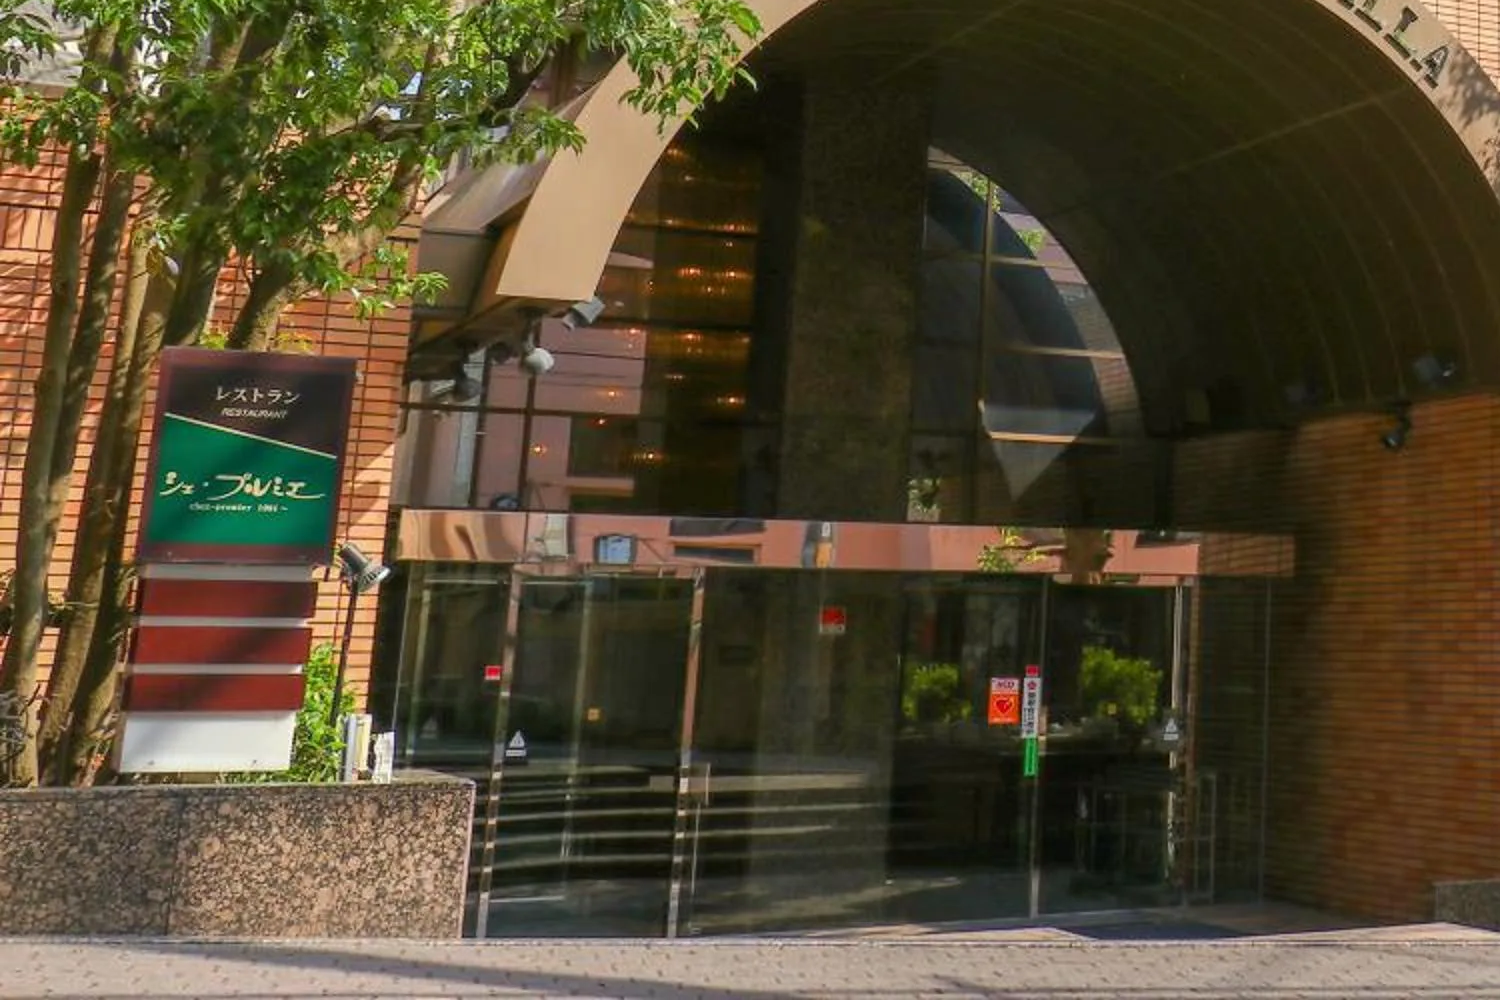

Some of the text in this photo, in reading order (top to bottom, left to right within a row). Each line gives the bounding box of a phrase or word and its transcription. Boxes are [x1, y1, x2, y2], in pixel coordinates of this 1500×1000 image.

[216, 386, 300, 404] レストラン
[221, 407, 289, 418] RESTAURANT
